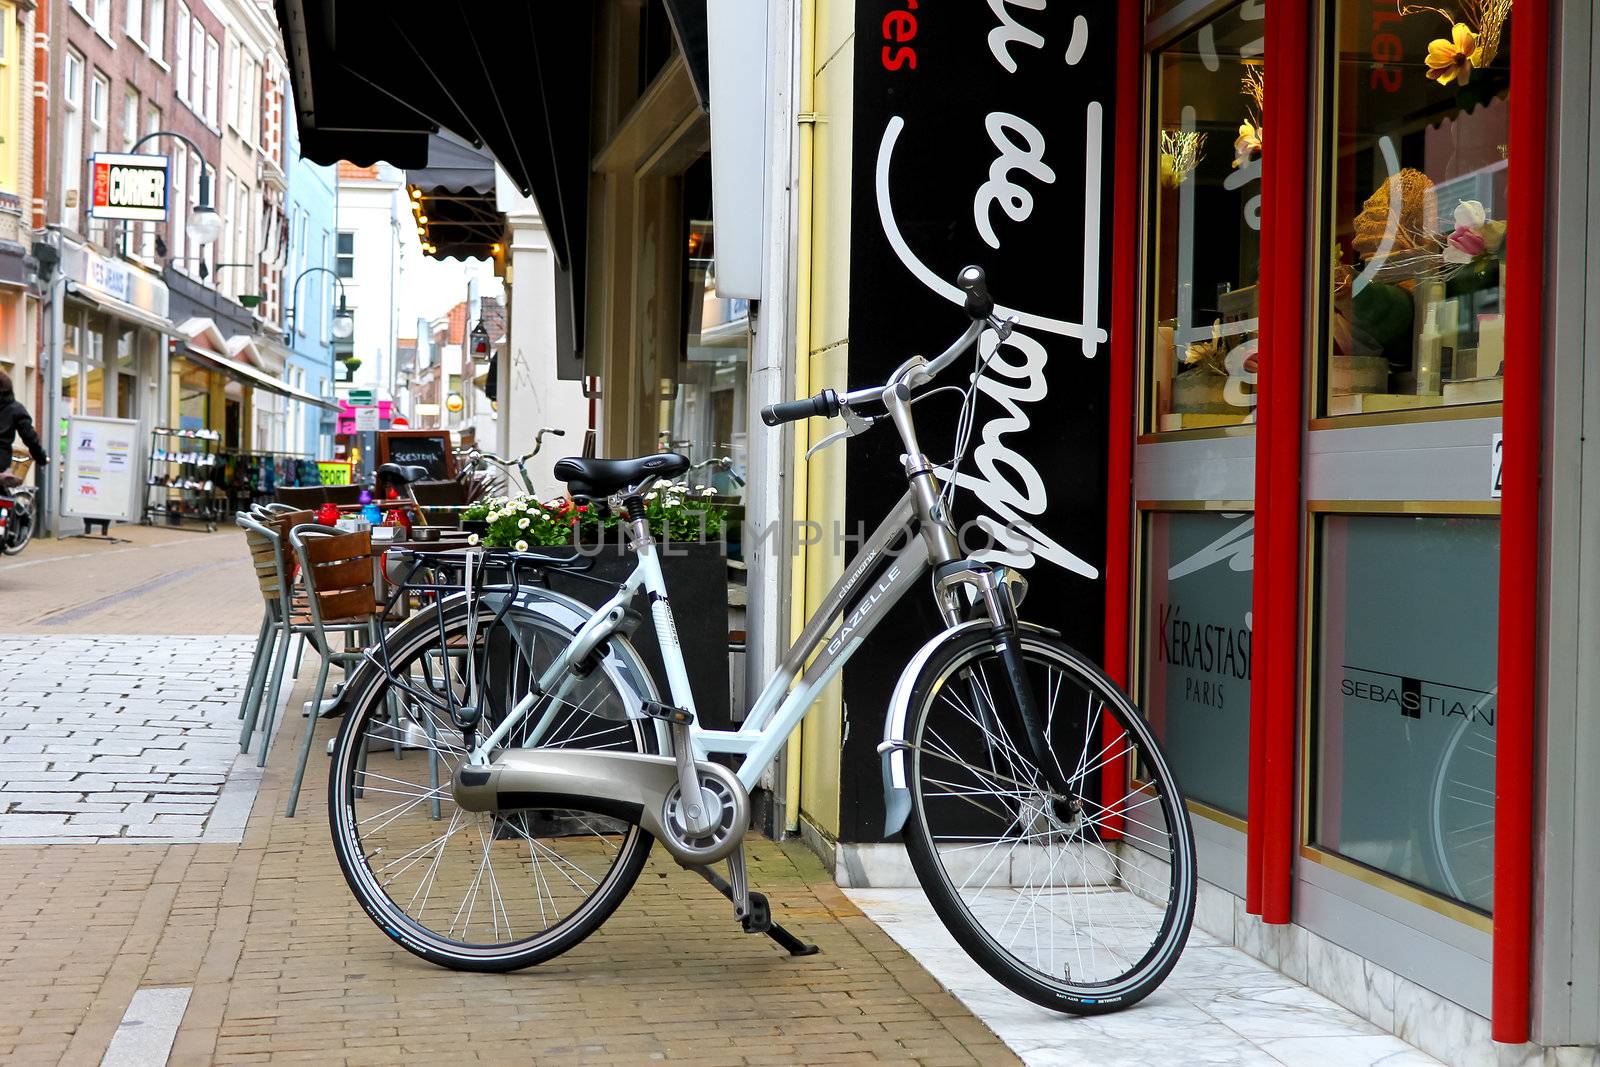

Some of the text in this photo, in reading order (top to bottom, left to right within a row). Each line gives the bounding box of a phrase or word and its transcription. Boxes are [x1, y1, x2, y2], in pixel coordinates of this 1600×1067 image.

[882, 0, 919, 71] es
[110, 167, 165, 206] CORNER
[974, 111, 1056, 249] de
[838, 549, 878, 600] chamonix
[827, 565, 901, 656] GAZELLE
[1186, 677, 1224, 709] PARIS
[1341, 679, 1494, 726] SEBASTIAN
